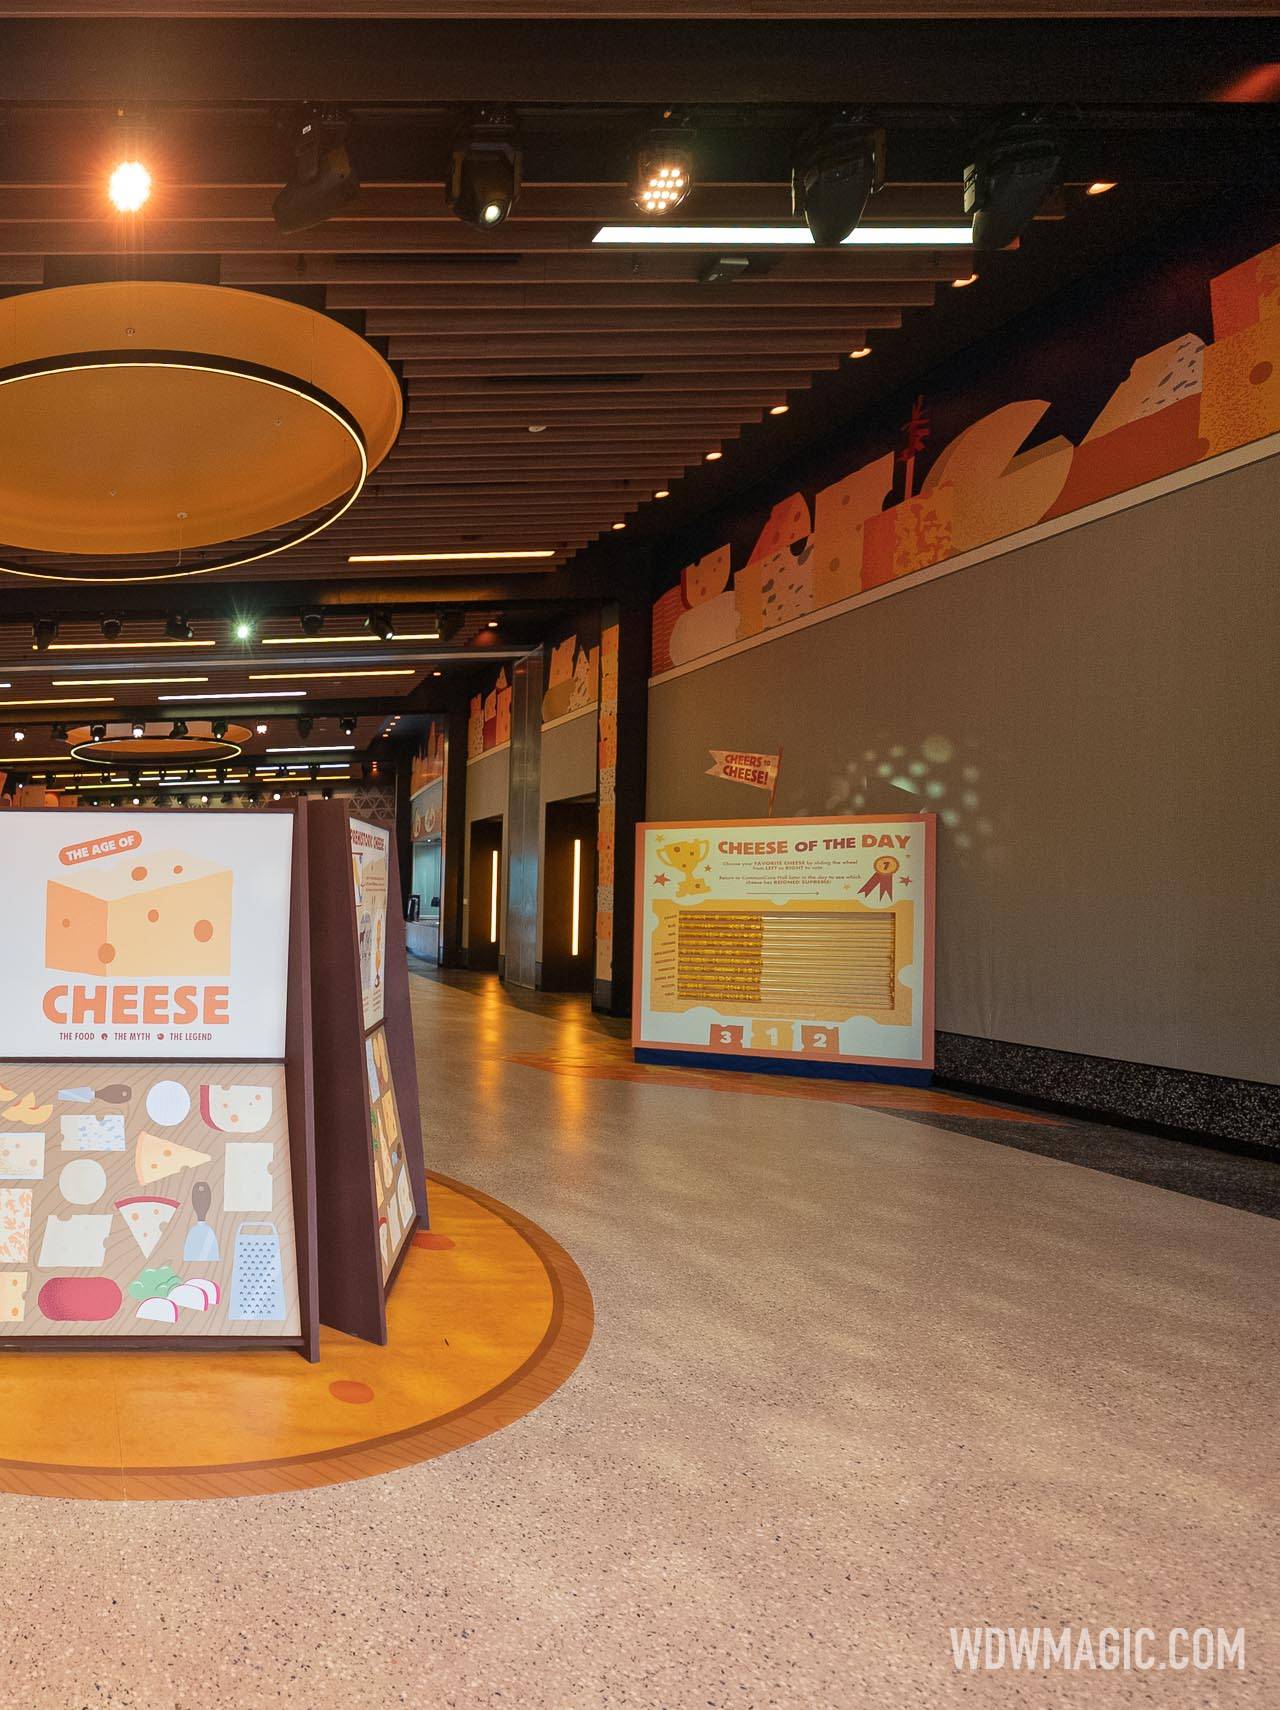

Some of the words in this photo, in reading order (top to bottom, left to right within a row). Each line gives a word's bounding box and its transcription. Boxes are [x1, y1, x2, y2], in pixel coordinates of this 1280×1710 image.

[725, 754, 762, 768] CHEERS
[723, 765, 769, 785] CHEESE!
[65, 847, 90, 862] THE
[92, 840, 116, 855] AGE
[118, 835, 135, 848] OF
[718, 840, 788, 856] CHEESE
[794, 840, 818, 852] OF
[823, 837, 856, 850] THE
[862, 834, 912, 849] DAY
[882, 862, 890, 870] 1
[42, 984, 231, 1026] CHEESE
[59, 1032, 72, 1040] THE
[75, 1032, 95, 1040] FOOD
[114, 1032, 128, 1040] THE
[130, 1032, 151, 1040] MYTH
[170, 1032, 182, 1040] THE
[185, 1032, 212, 1040] LEGEND
[720, 1031, 732, 1044] 3
[766, 1027, 778, 1047] 1
[813, 1033, 827, 1048] 2
